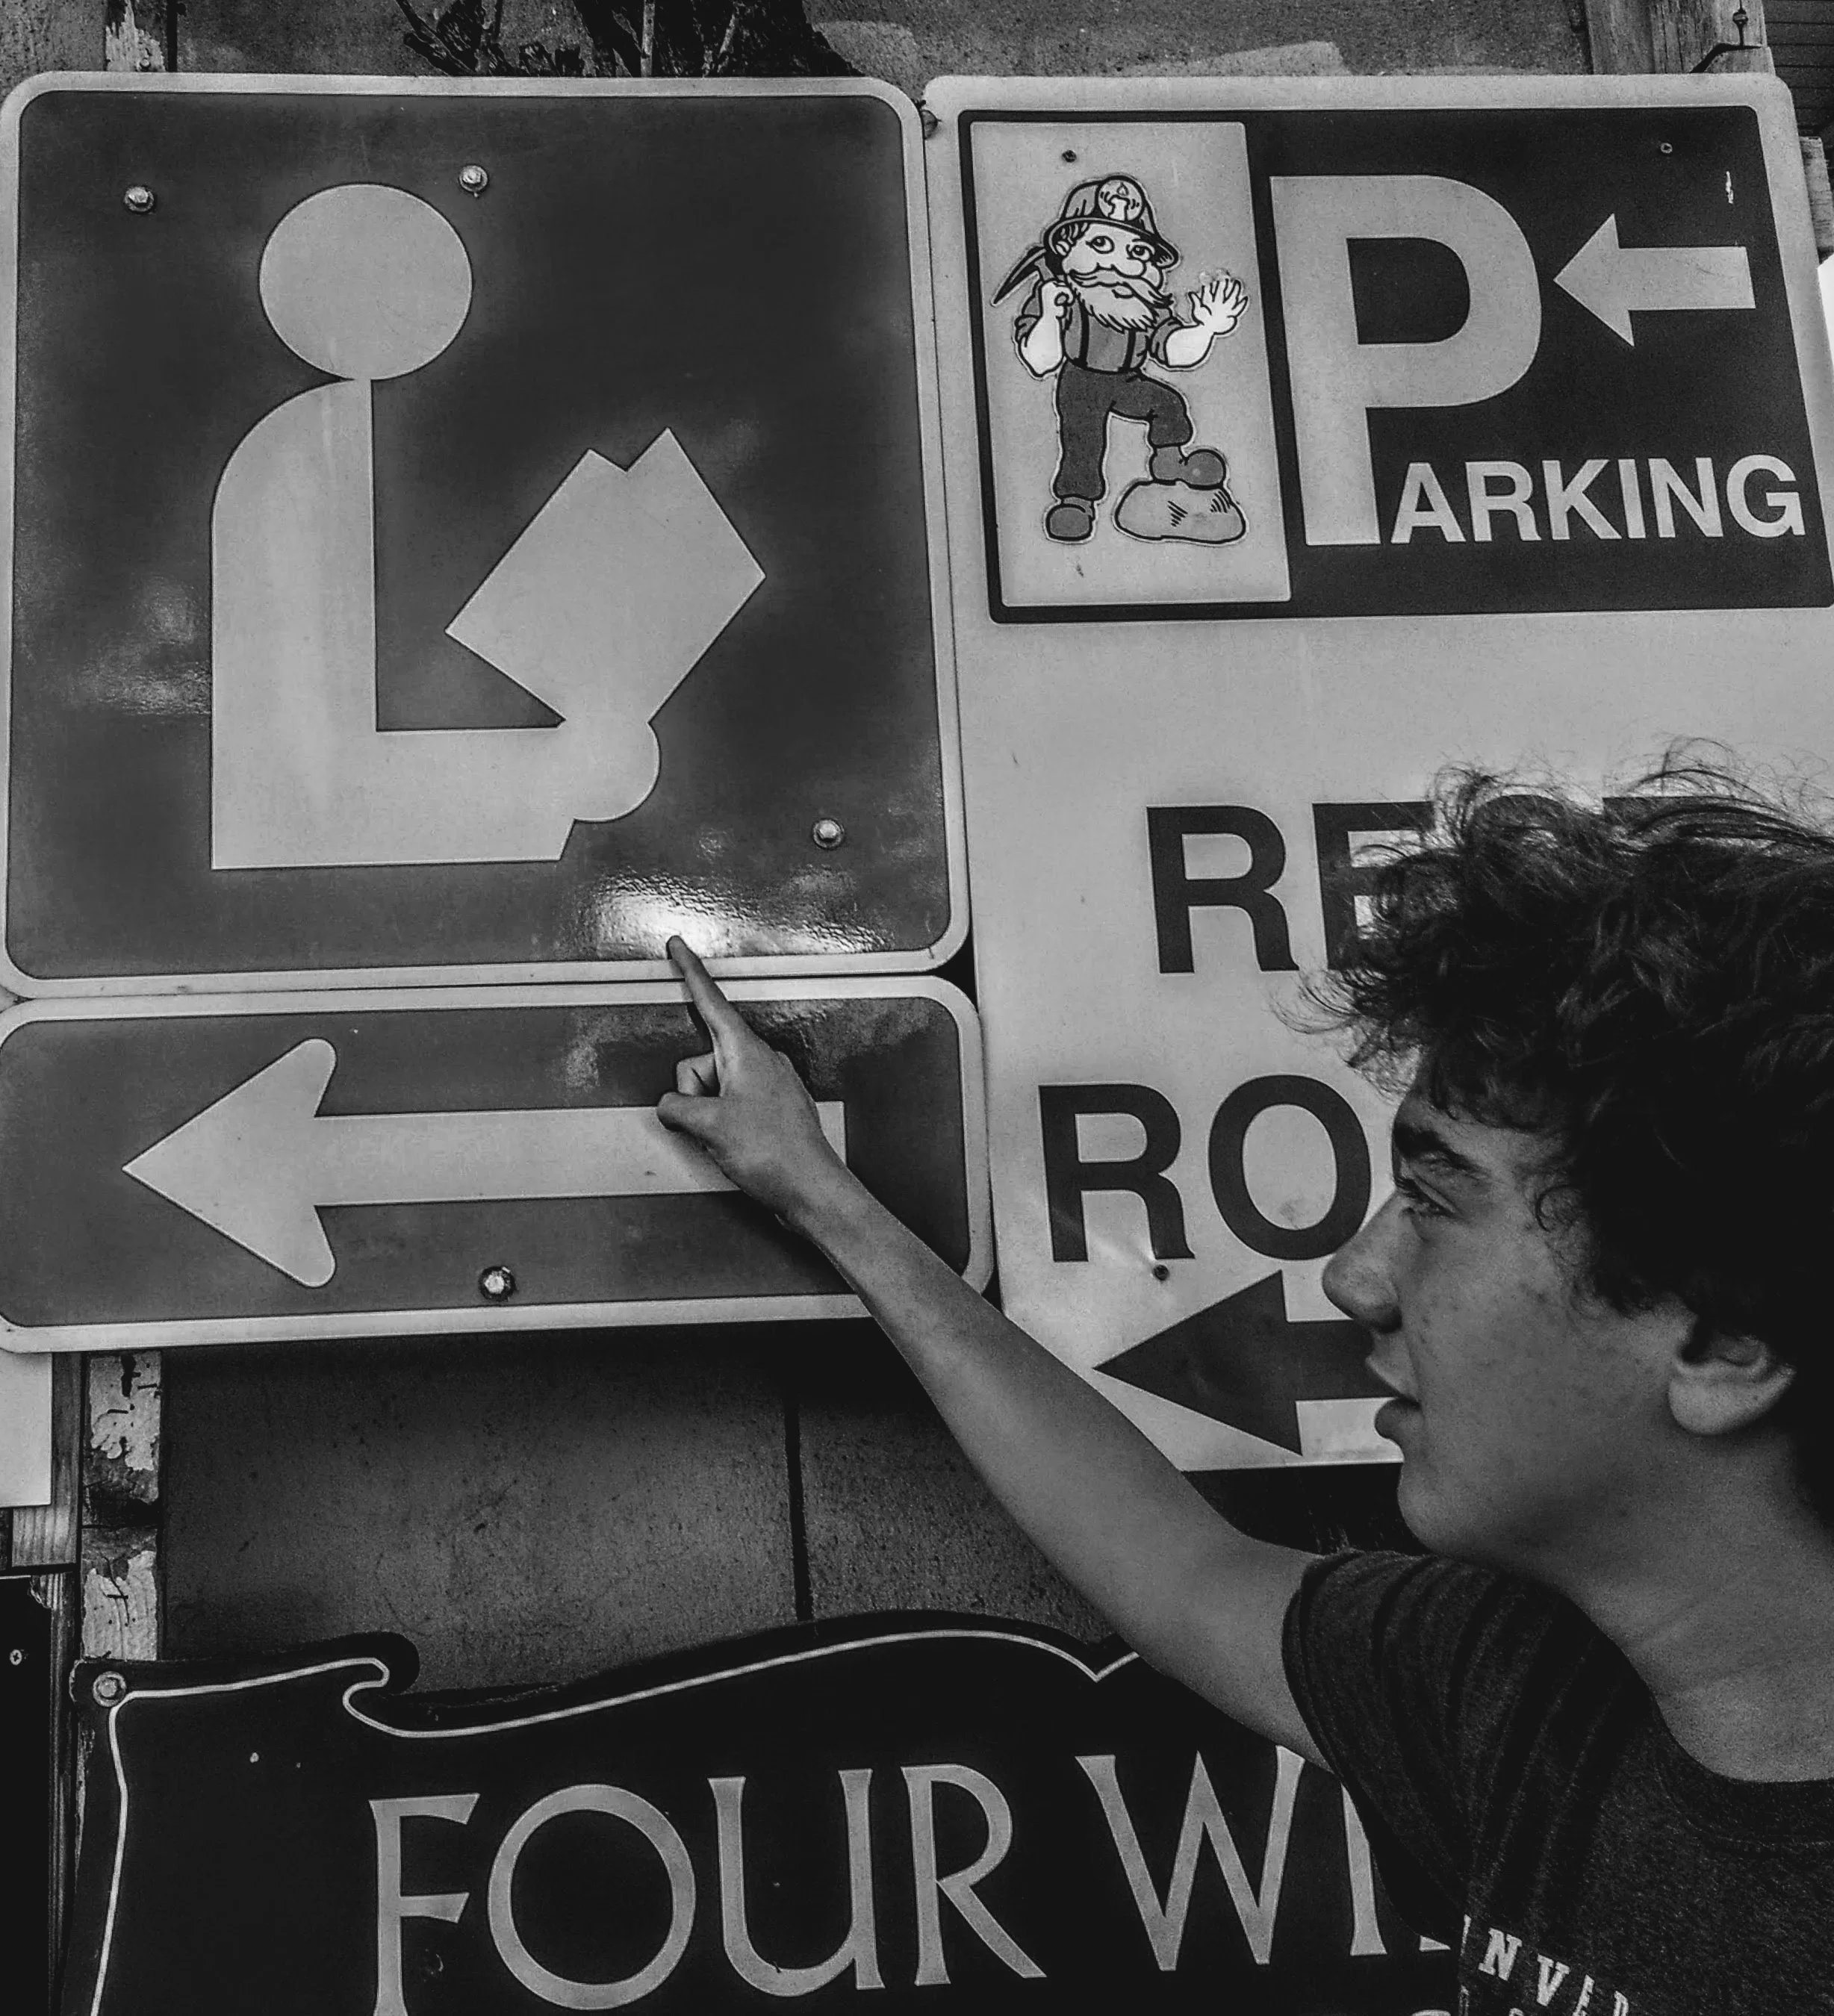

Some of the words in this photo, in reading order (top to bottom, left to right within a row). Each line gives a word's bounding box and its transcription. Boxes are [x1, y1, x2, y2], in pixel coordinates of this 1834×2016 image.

[1039, 1075, 1372, 1262] RO
[369, 1764, 1047, 2016] FOUR
[1075, 1745, 1452, 1972] WI
